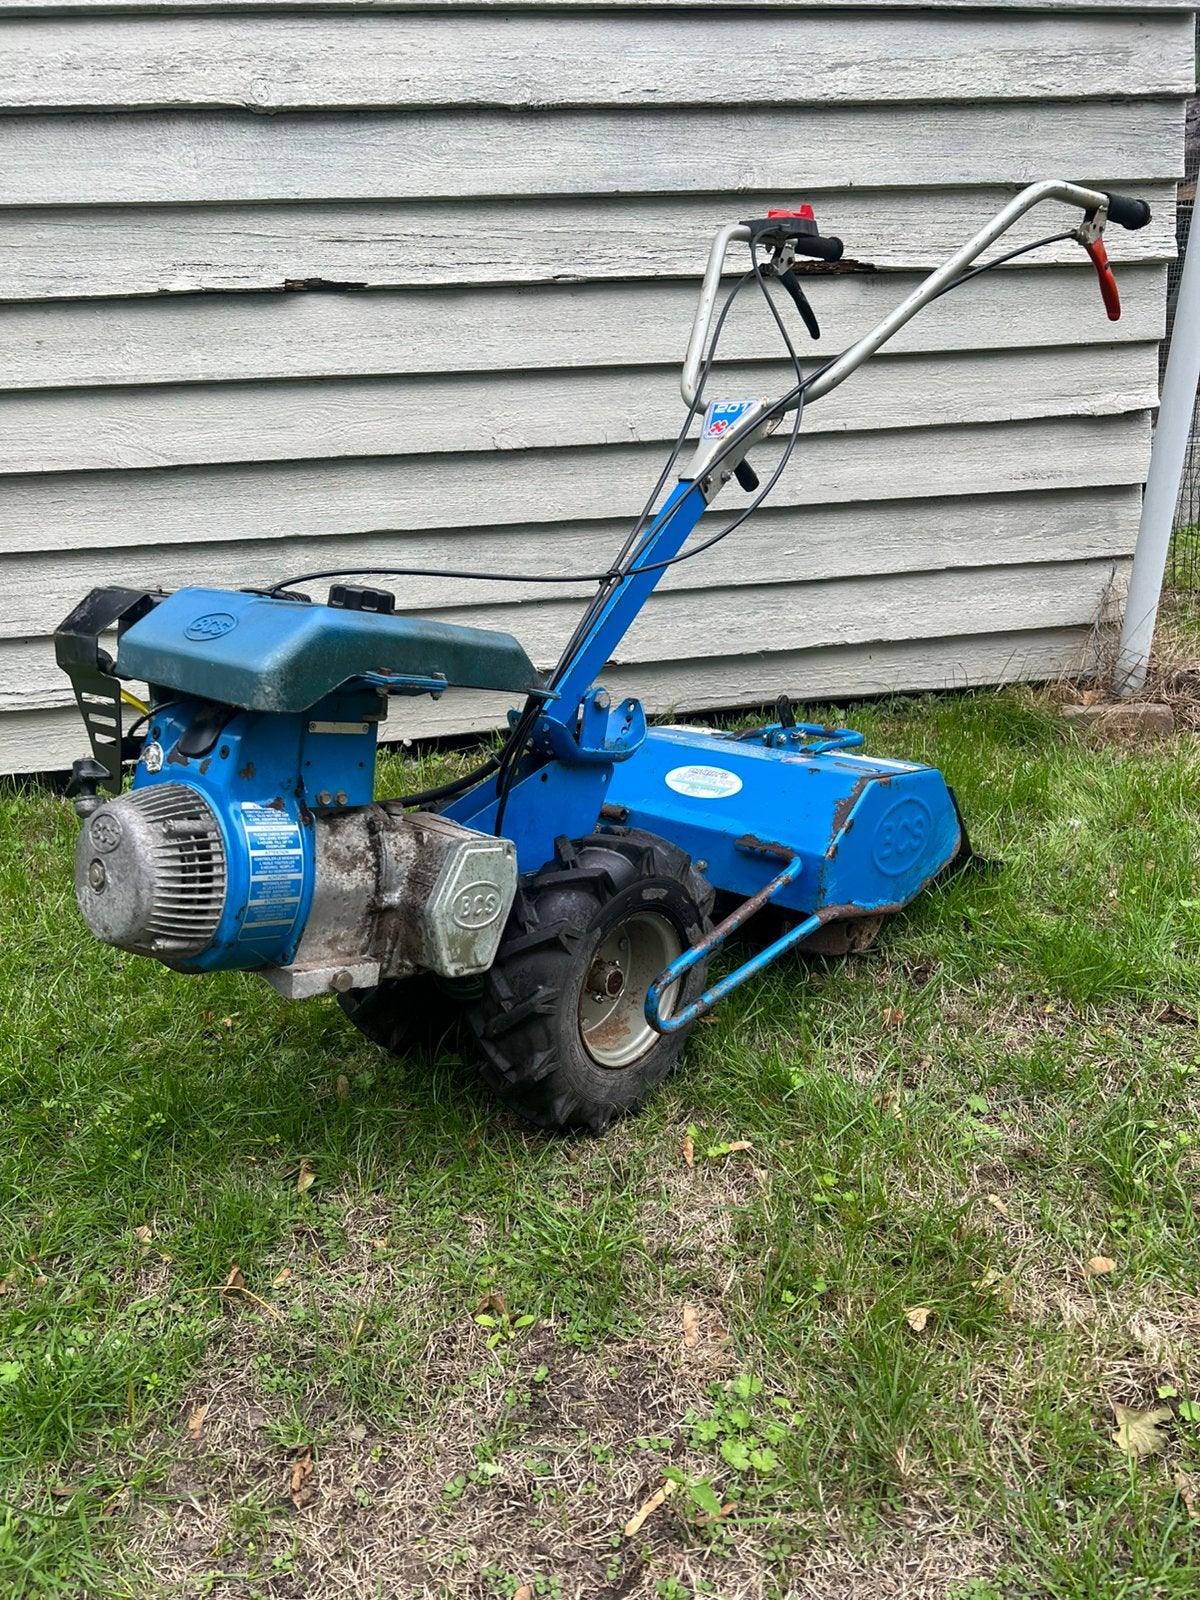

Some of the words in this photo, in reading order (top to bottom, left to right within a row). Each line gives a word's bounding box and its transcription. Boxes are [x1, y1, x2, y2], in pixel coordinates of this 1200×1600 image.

[714, 403, 748, 414] 201
[189, 618, 231, 636] BCS
[92, 822, 120, 846] BCS
[879, 815, 925, 861] BCS
[460, 894, 496, 918] BCS
